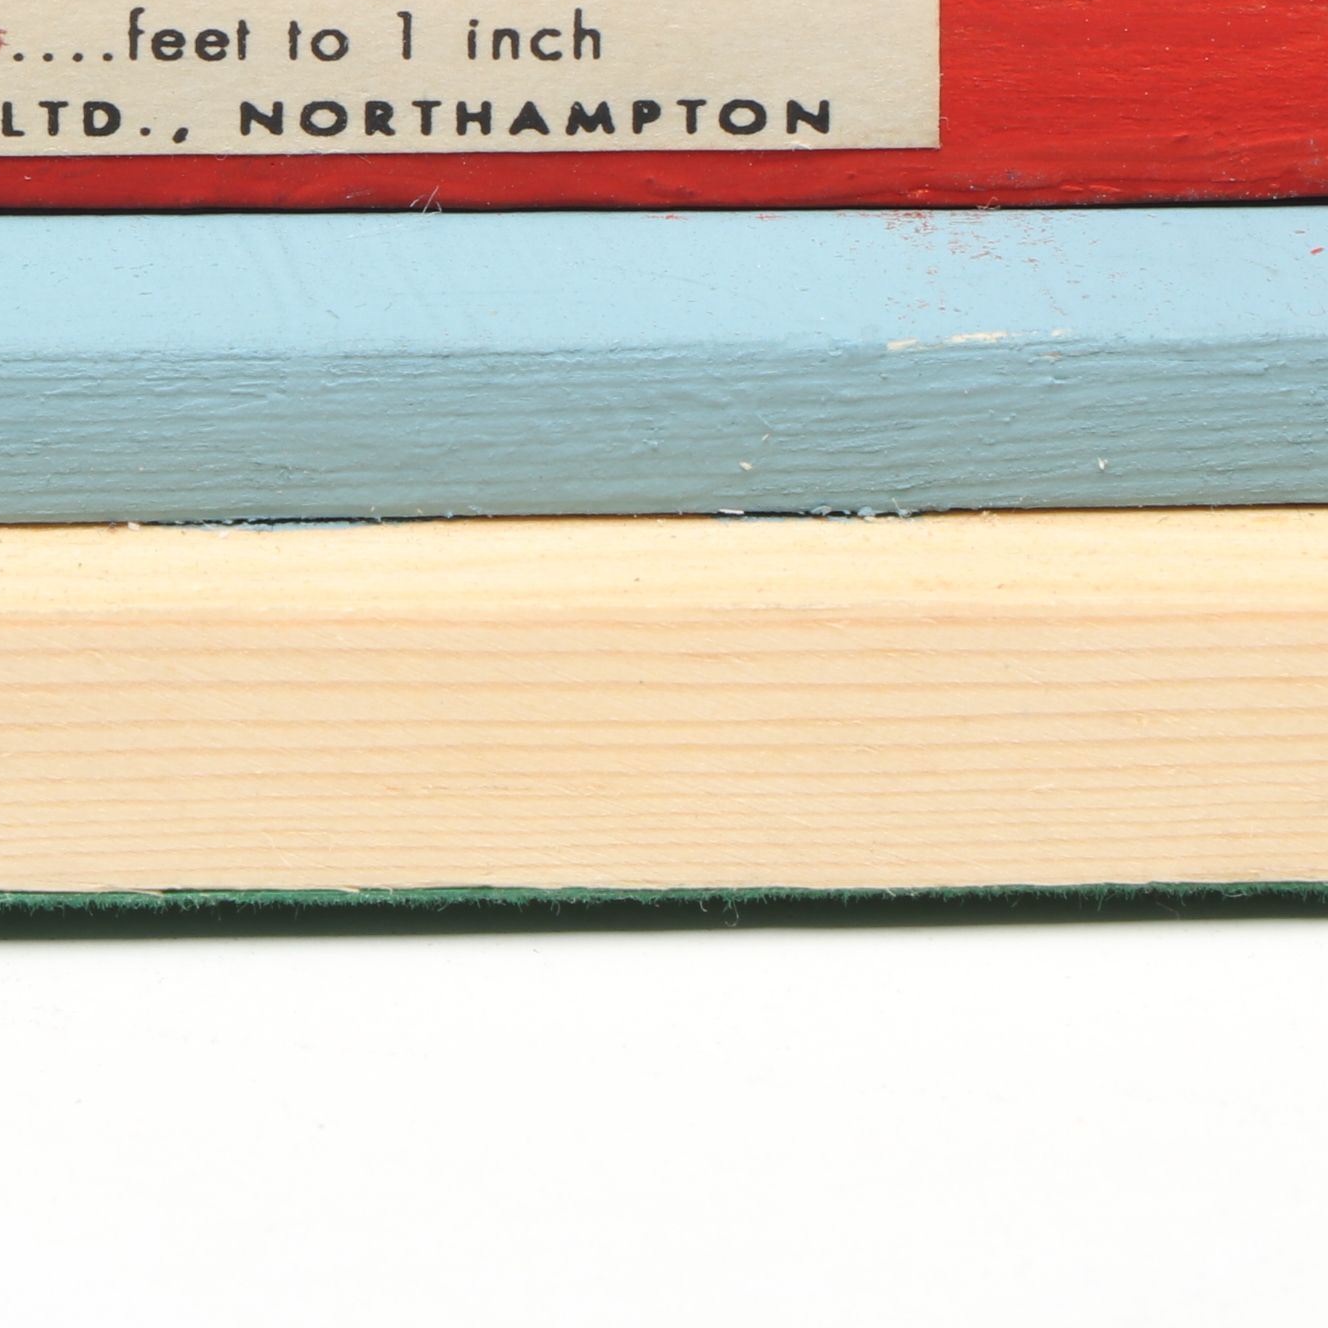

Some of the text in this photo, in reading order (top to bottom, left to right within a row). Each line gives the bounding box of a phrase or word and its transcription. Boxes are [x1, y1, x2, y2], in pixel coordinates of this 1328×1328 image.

[287, 20, 350, 63] to
[396, 10, 413, 61] 1
[466, 7, 602, 62] inch
[0, 99, 192, 149] LTD.,
[239, 98, 831, 138] NORTHAMPTON
